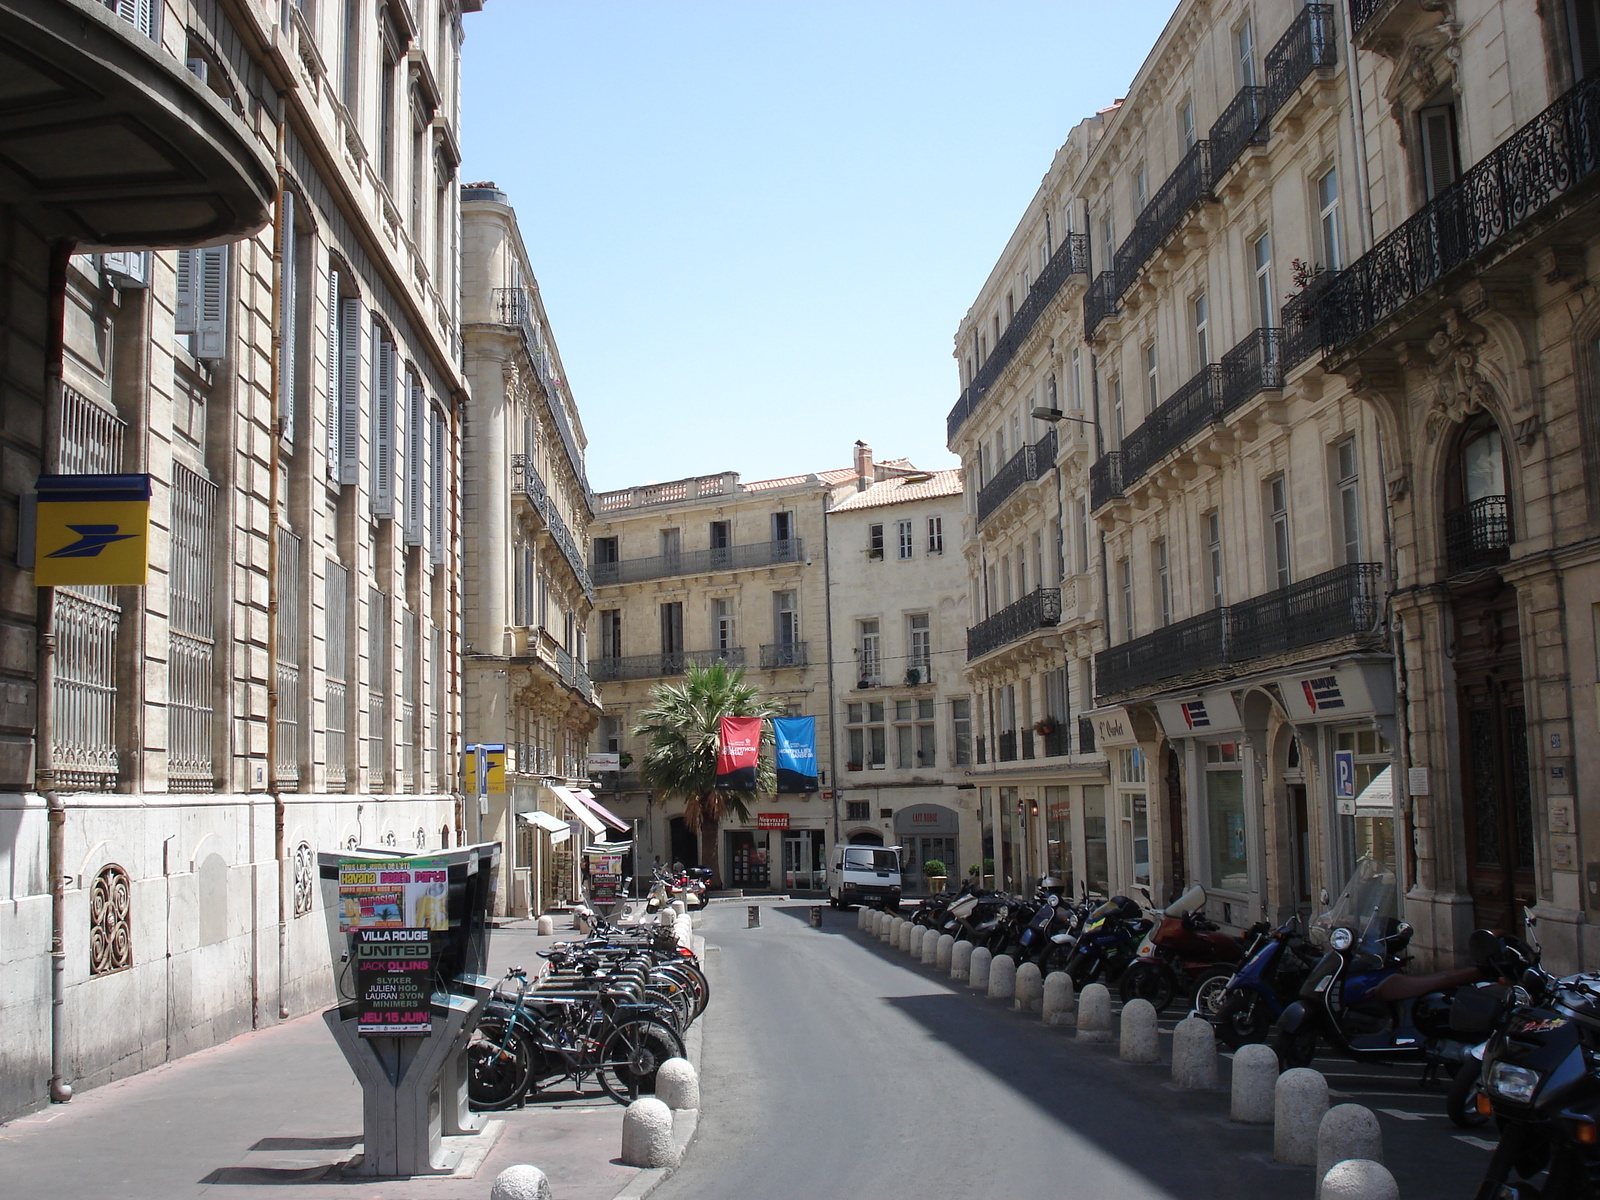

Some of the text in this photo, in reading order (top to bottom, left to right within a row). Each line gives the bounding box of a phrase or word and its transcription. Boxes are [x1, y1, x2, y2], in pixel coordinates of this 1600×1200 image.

[1309, 675, 1338, 690] BANQUE
[1340, 760, 1349, 789] P
[341, 871, 377, 885] Havana
[361, 930, 428, 941] VILLA ROUGE
[360, 945, 429, 957] UNITED
[360, 962, 386, 971] JACK
[387, 961, 429, 970] OLLINS
[368, 984, 418, 992] JULIEN HOO
[365, 992, 424, 1000] LAURAN SYON
[372, 1000, 419, 1008] MINIMERS
[360, 1011, 428, 1023] JEU 15 JUIN
